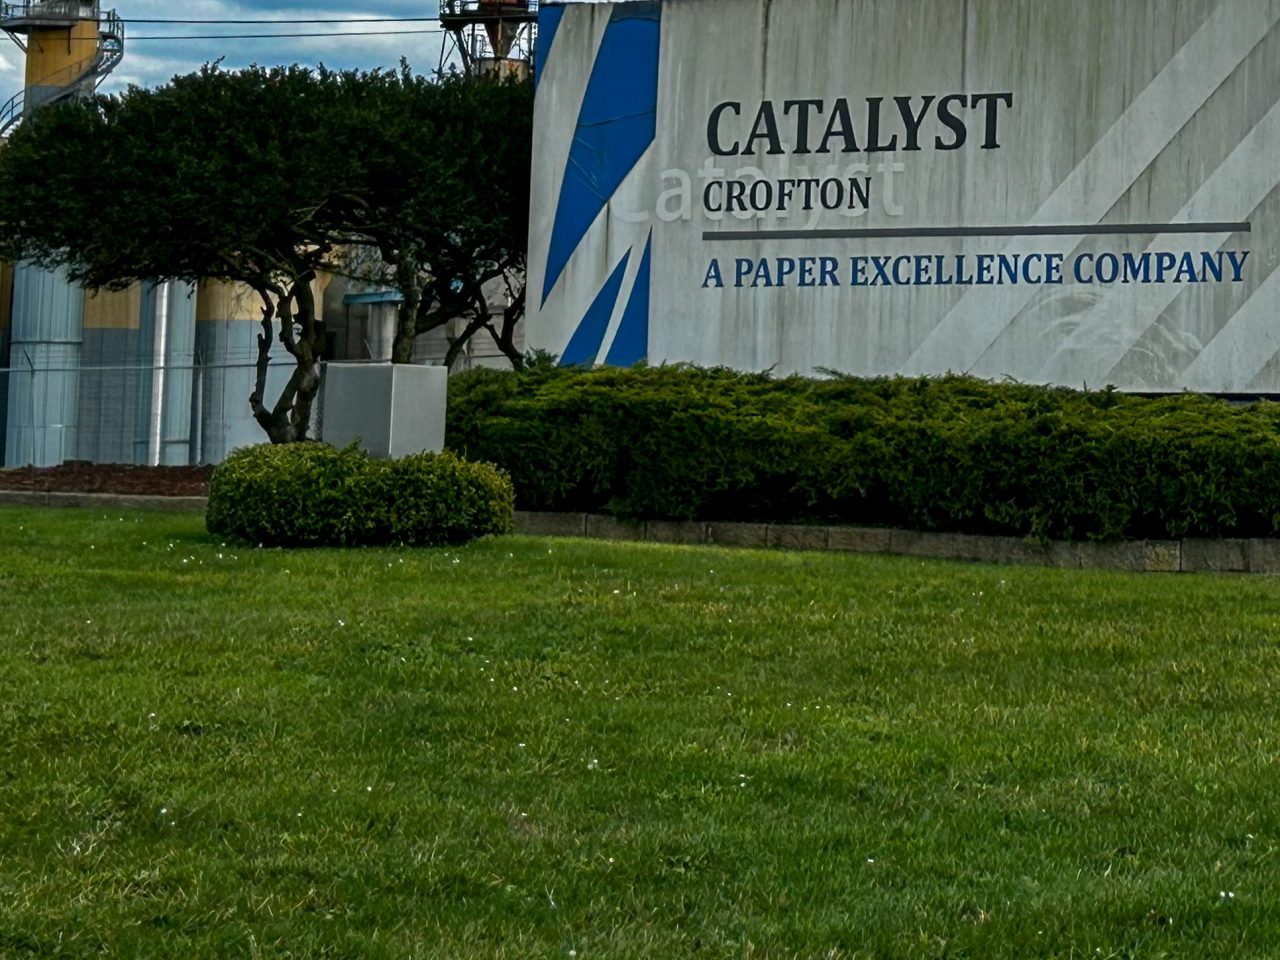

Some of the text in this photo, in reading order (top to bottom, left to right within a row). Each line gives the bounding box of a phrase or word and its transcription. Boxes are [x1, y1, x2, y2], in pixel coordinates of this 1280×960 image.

[706, 92, 1013, 156] CATALYST
[703, 177, 872, 212] CROFTON
[702, 251, 1250, 288] A PAPER EXCELLENCE COMPANY
